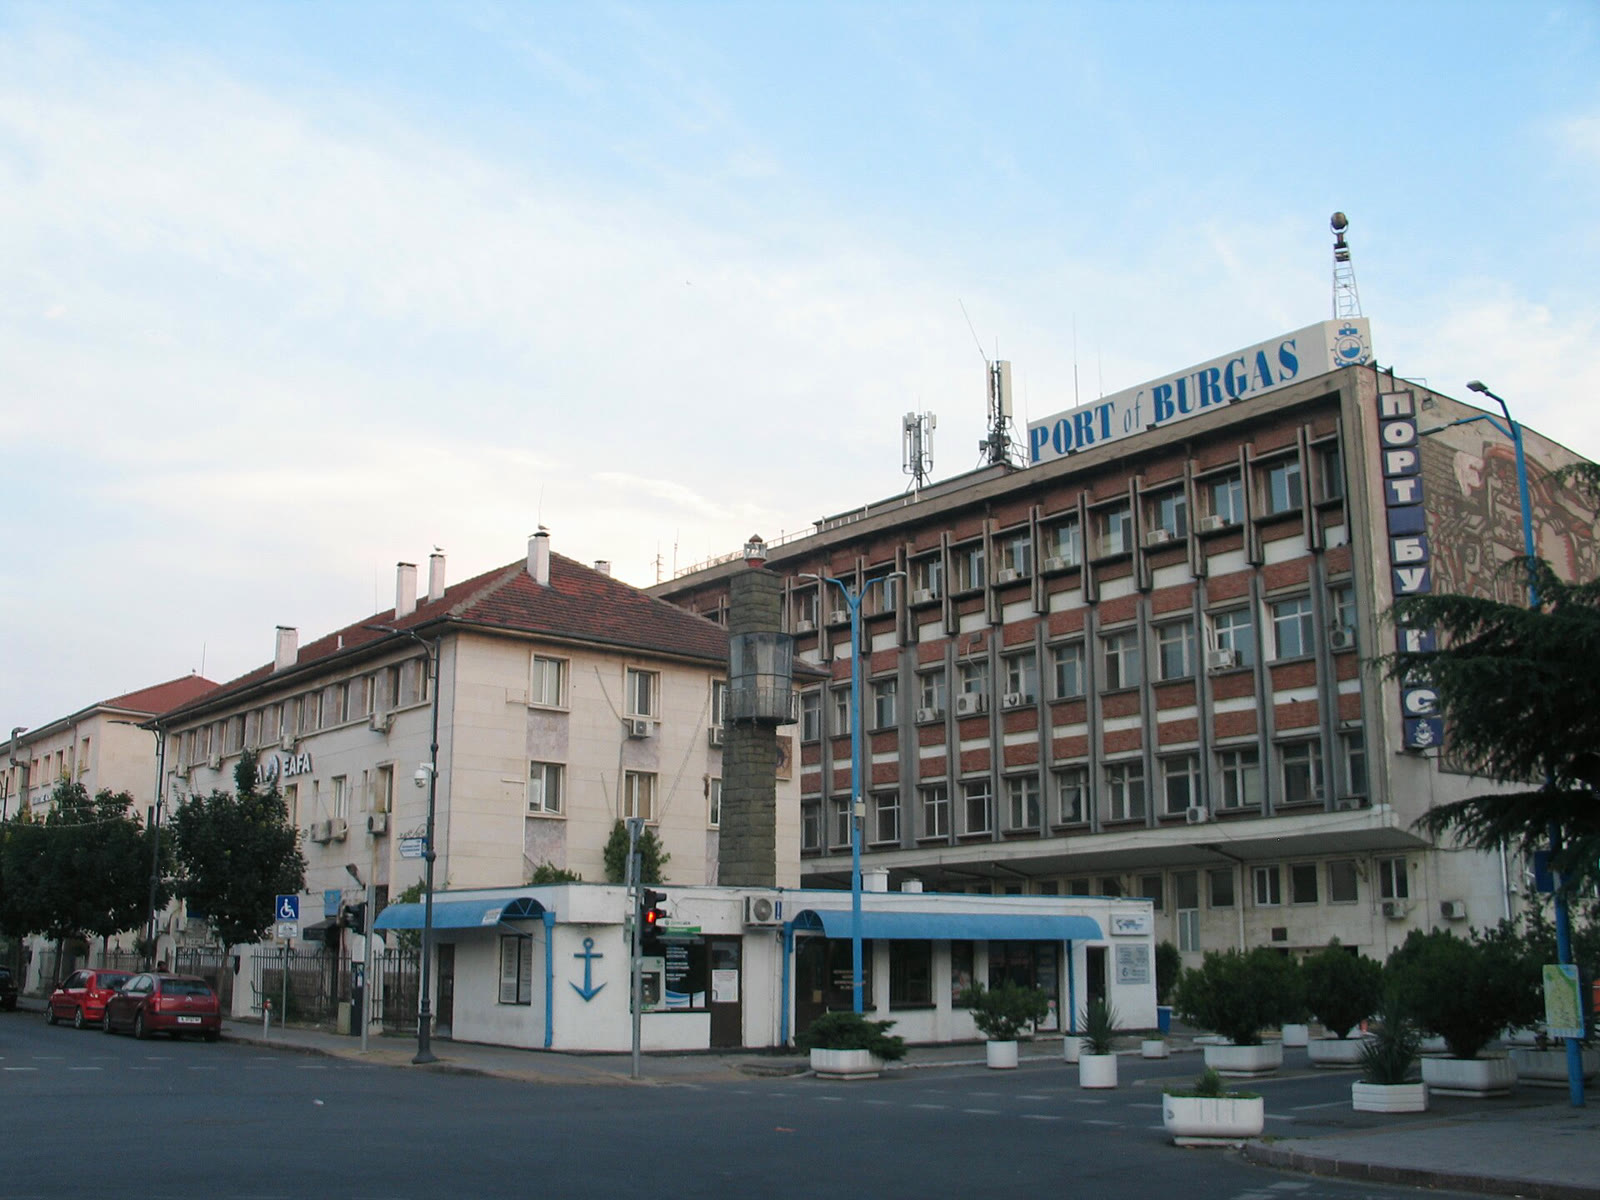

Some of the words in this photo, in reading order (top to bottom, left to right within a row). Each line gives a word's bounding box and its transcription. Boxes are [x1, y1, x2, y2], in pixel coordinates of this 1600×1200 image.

[1029, 401, 1115, 463] PORT
[1123, 391, 1144, 433] of
[1151, 339, 1299, 423] BURGAS
[1381, 391, 1416, 503] ПОРТ
[1395, 537, 1438, 714] БУГС
[282, 752, 312, 777] EAFA
